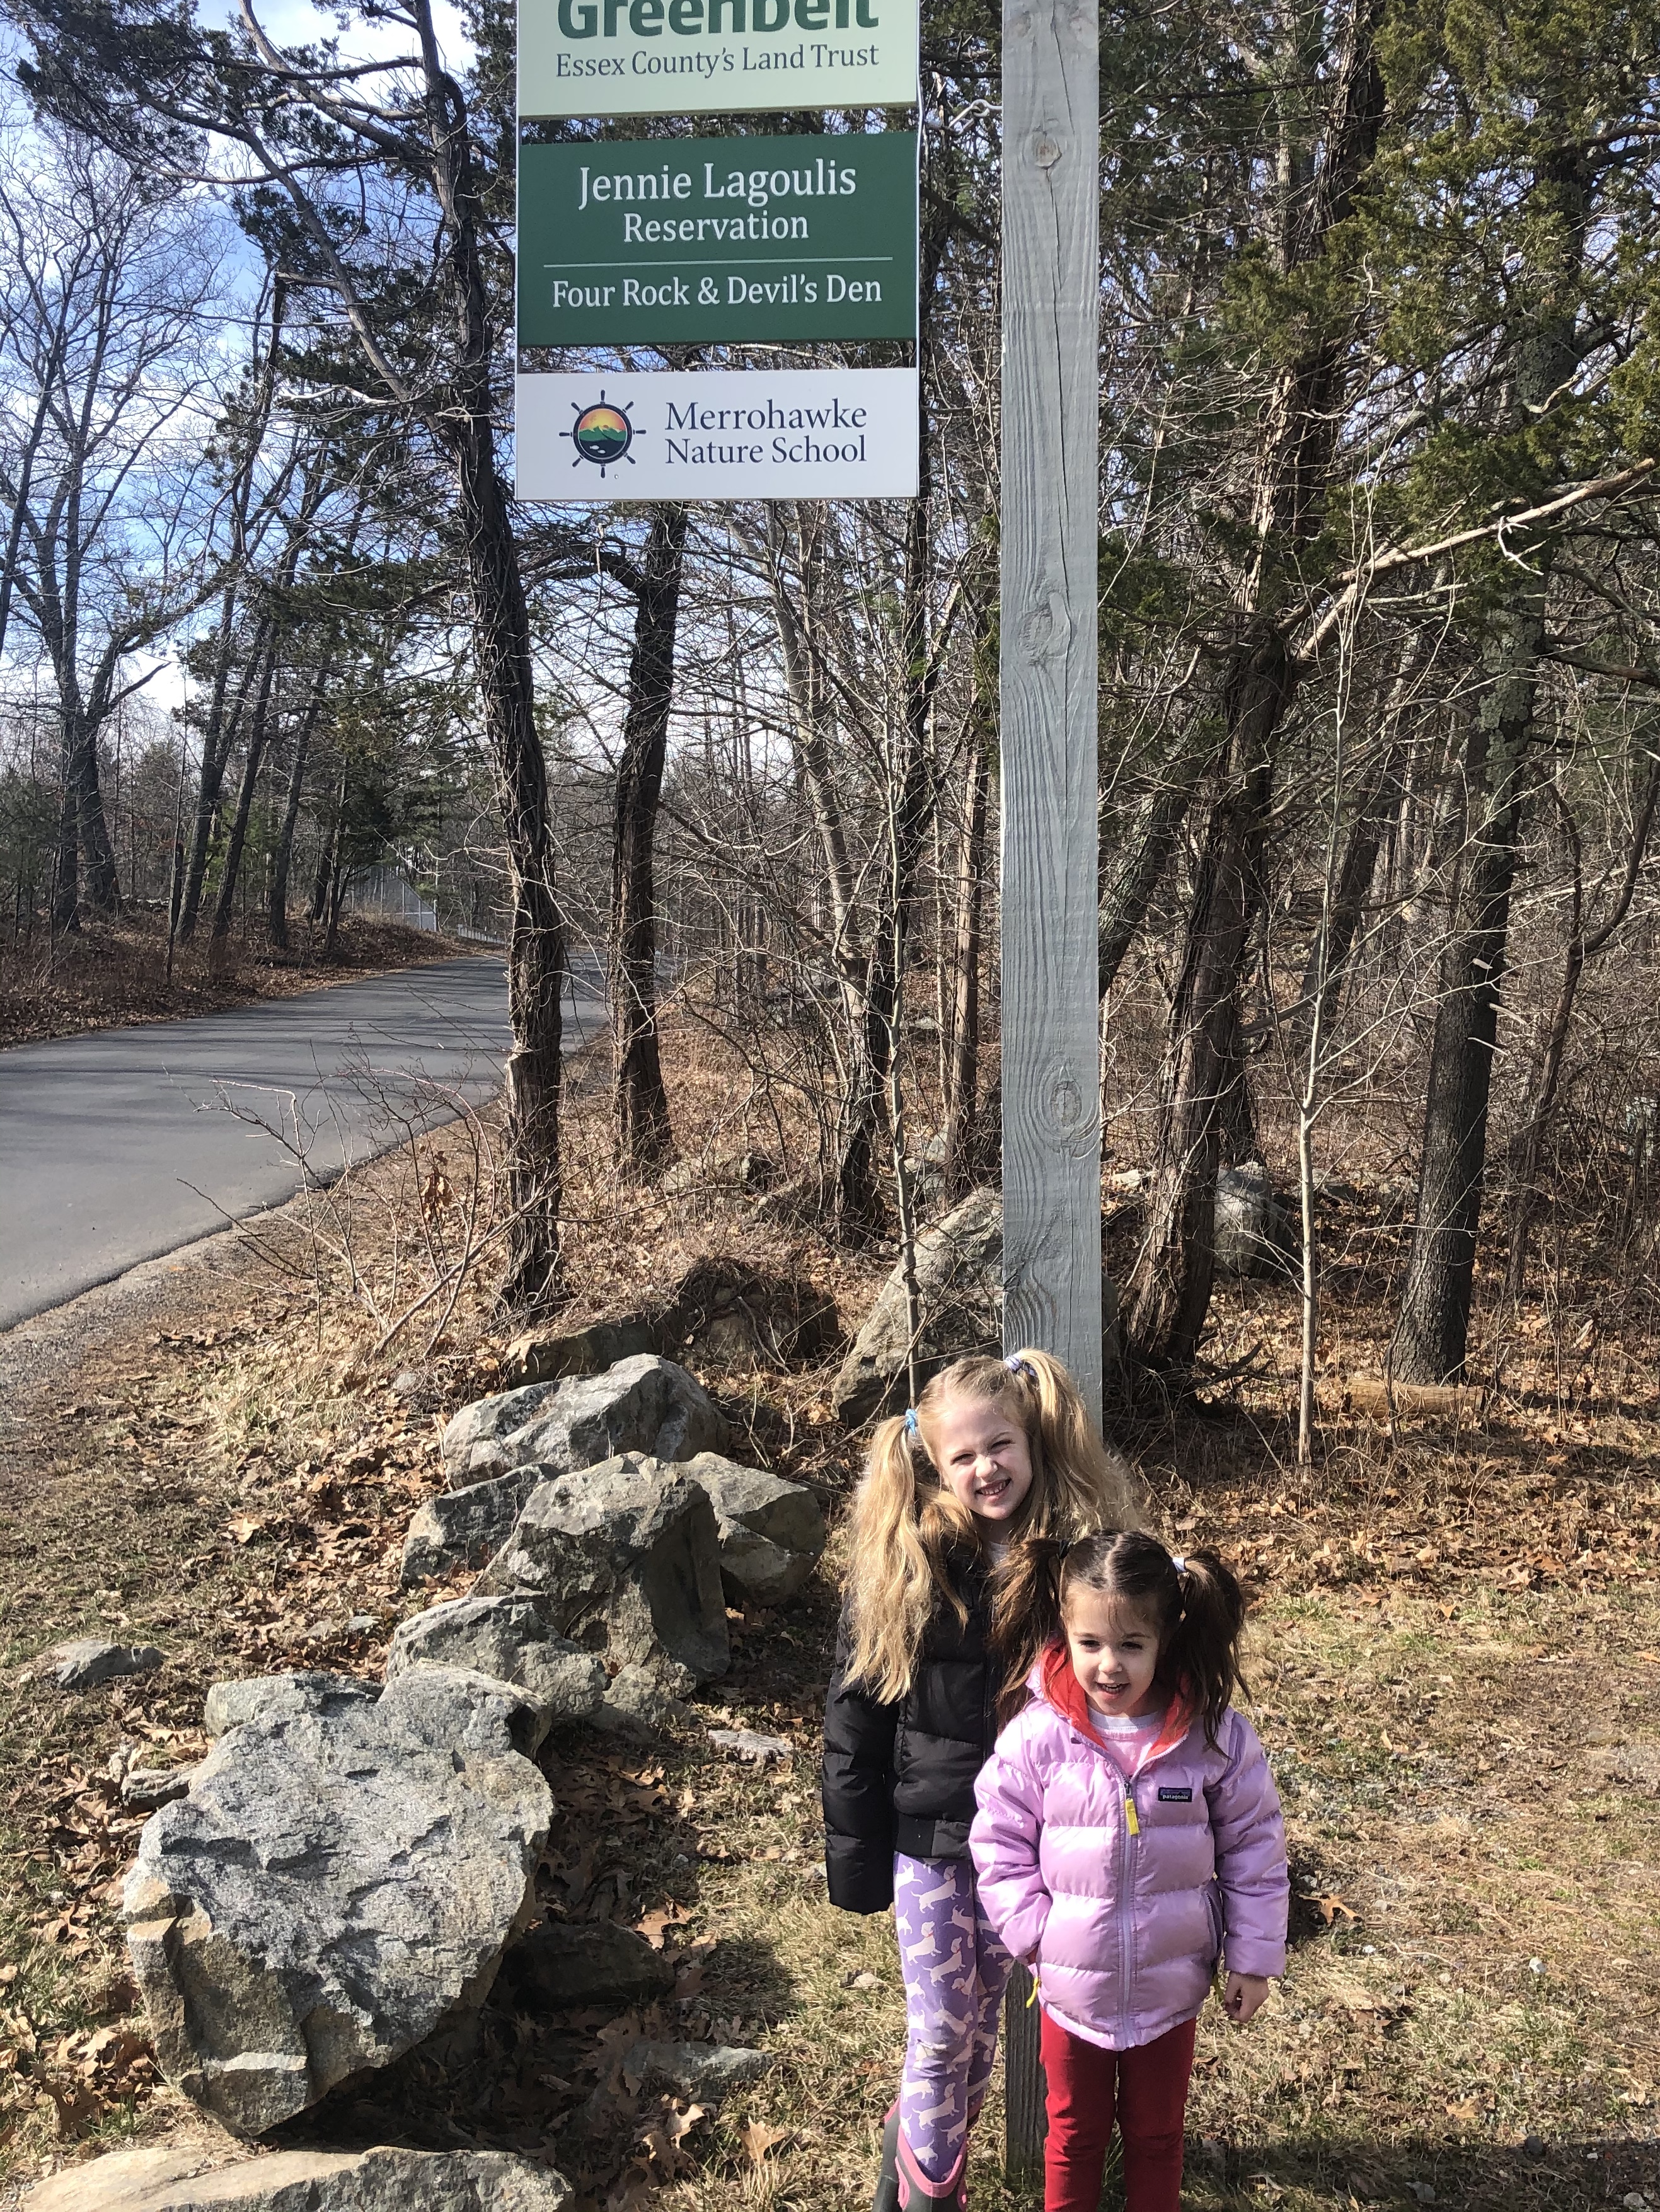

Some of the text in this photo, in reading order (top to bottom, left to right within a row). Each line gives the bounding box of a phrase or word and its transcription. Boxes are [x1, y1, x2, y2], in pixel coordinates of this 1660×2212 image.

[556, 43, 880, 79] Essex County's Land Trust
[578, 158, 857, 210] Jennie Lagoulis
[623, 209, 810, 243] Reservation
[553, 274, 883, 308] Four Rock & Devil's Den
[664, 398, 868, 431] Merrohawke
[664, 434, 867, 464] Nature School
